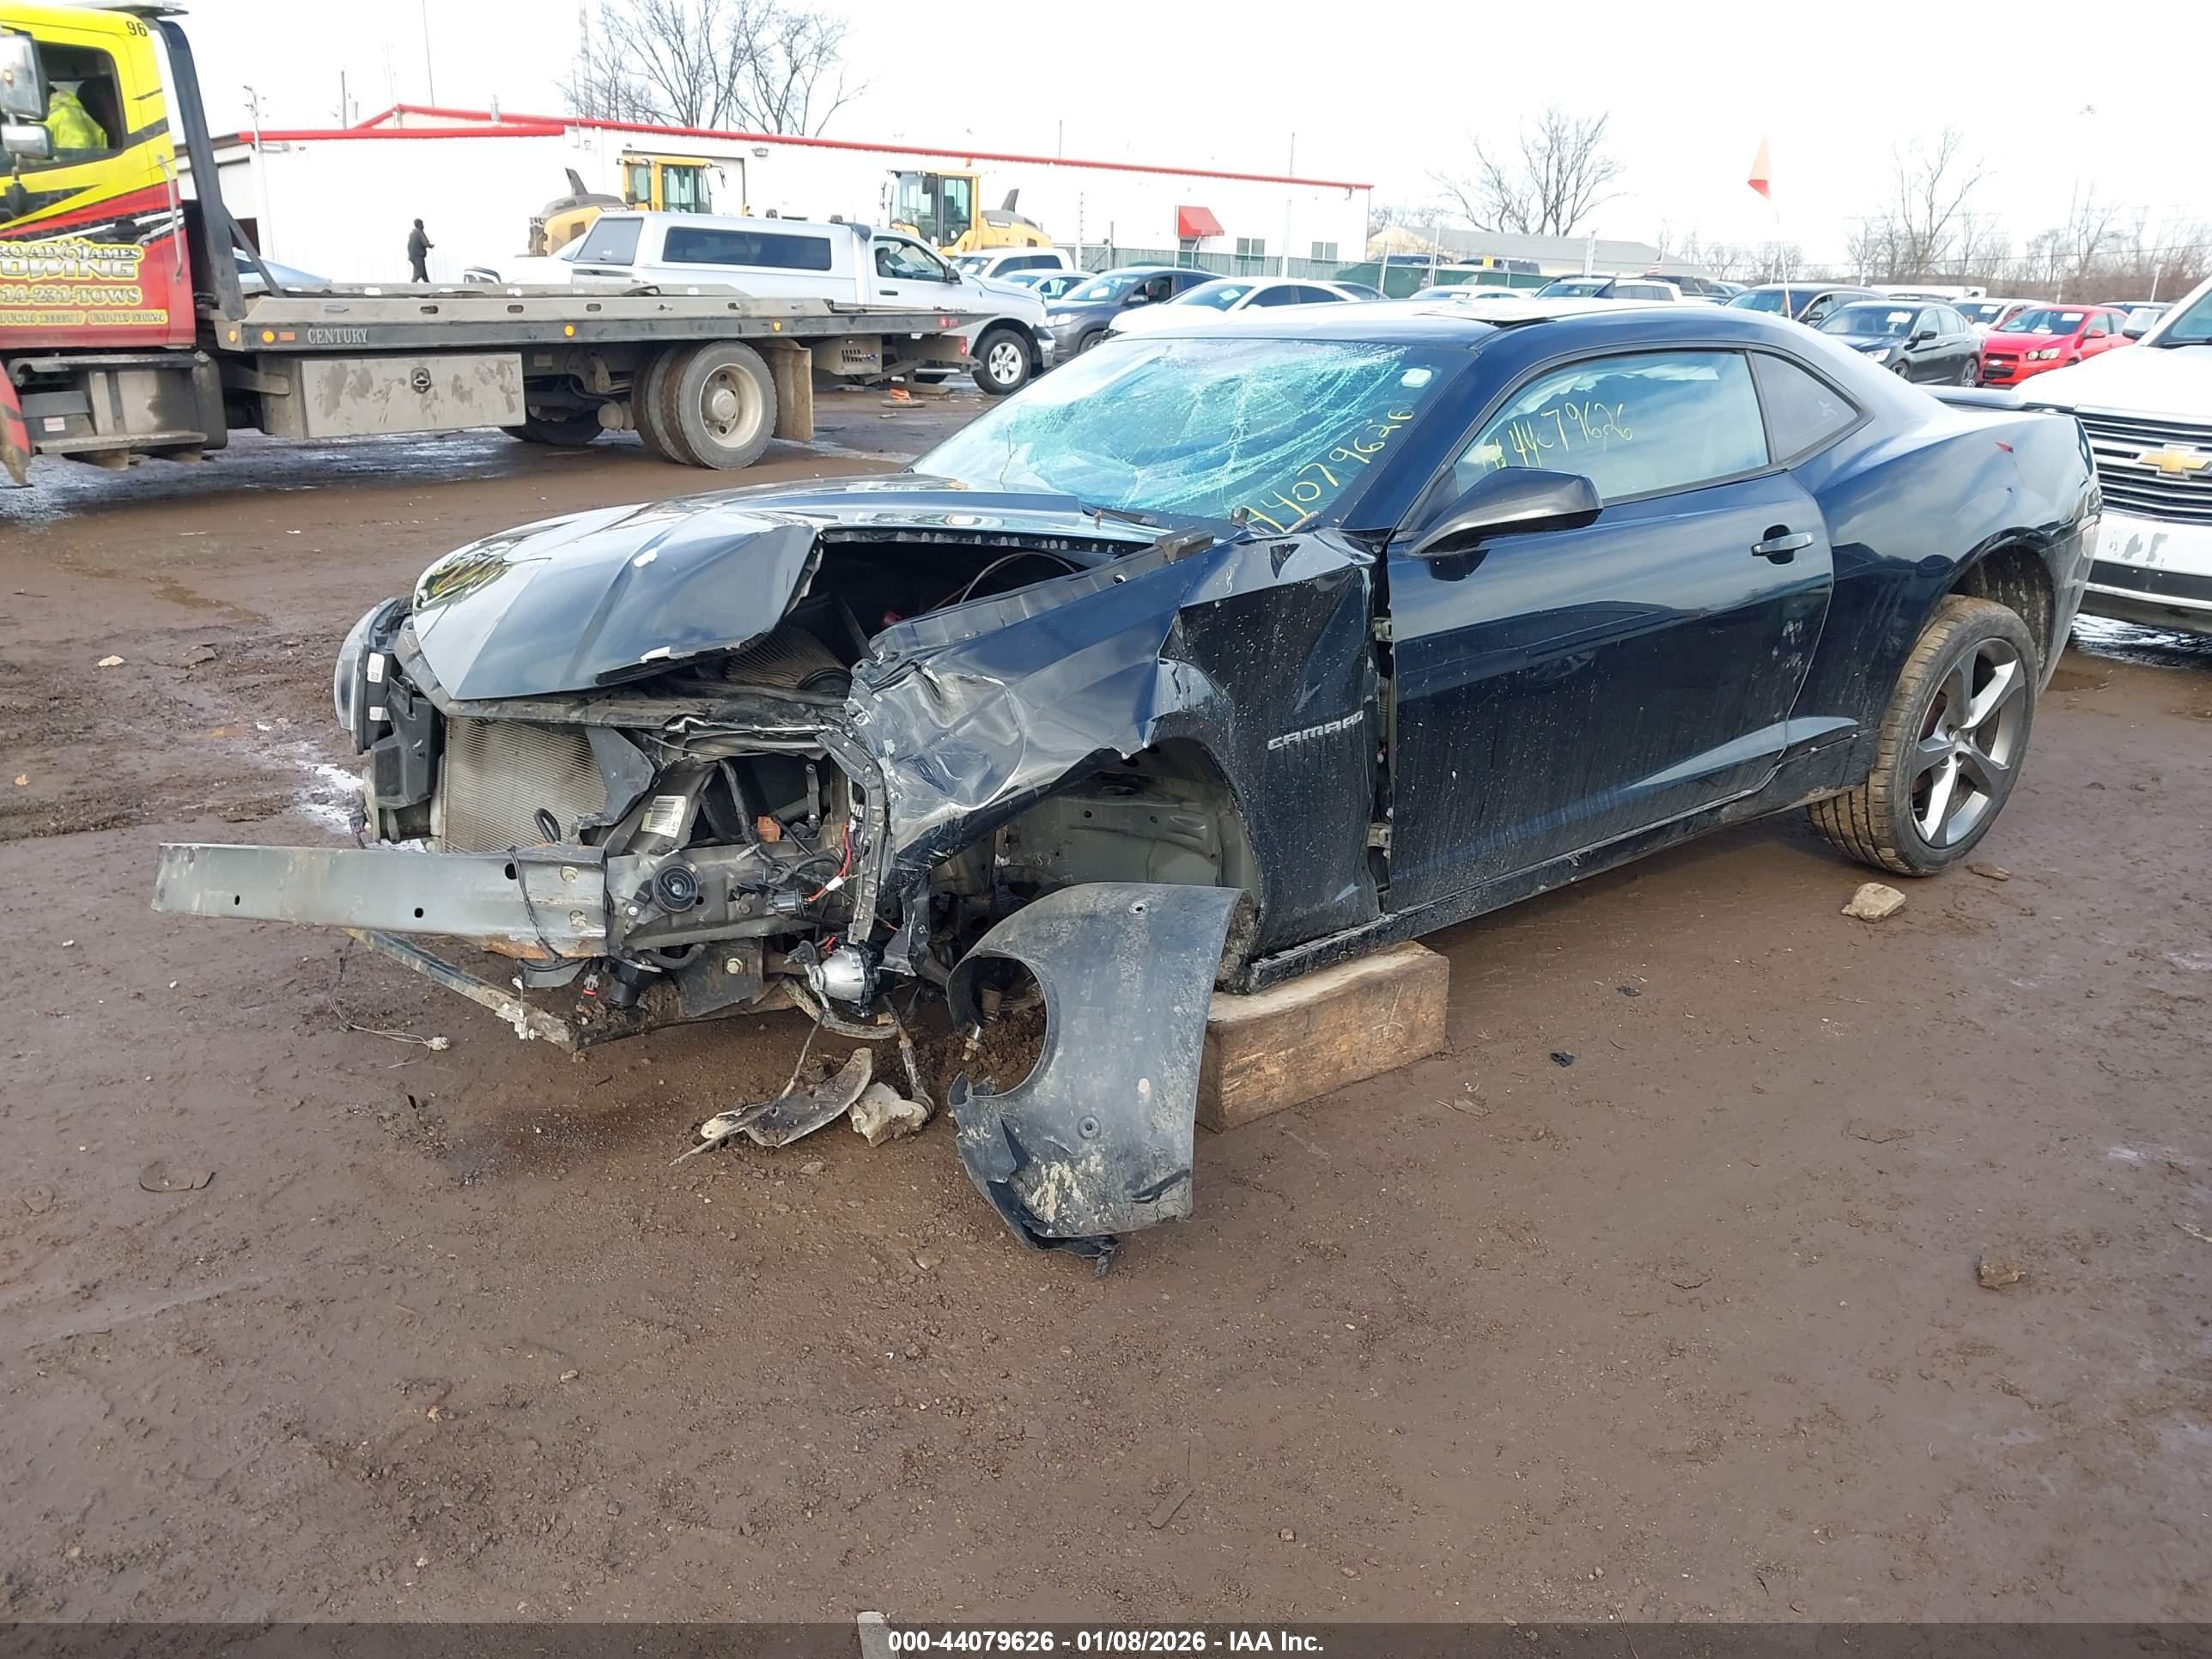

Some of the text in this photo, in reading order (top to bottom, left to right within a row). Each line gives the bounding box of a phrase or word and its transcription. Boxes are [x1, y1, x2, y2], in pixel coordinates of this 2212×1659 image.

[126, 21, 148, 37] 96
[76, 244, 141, 262] JAMES
[0, 258, 135, 279] OWING
[0, 287, 139, 303] 14-231-TOWS
[307, 328, 369, 344] CENTURY
[1267, 710, 1364, 750] CAMARO
